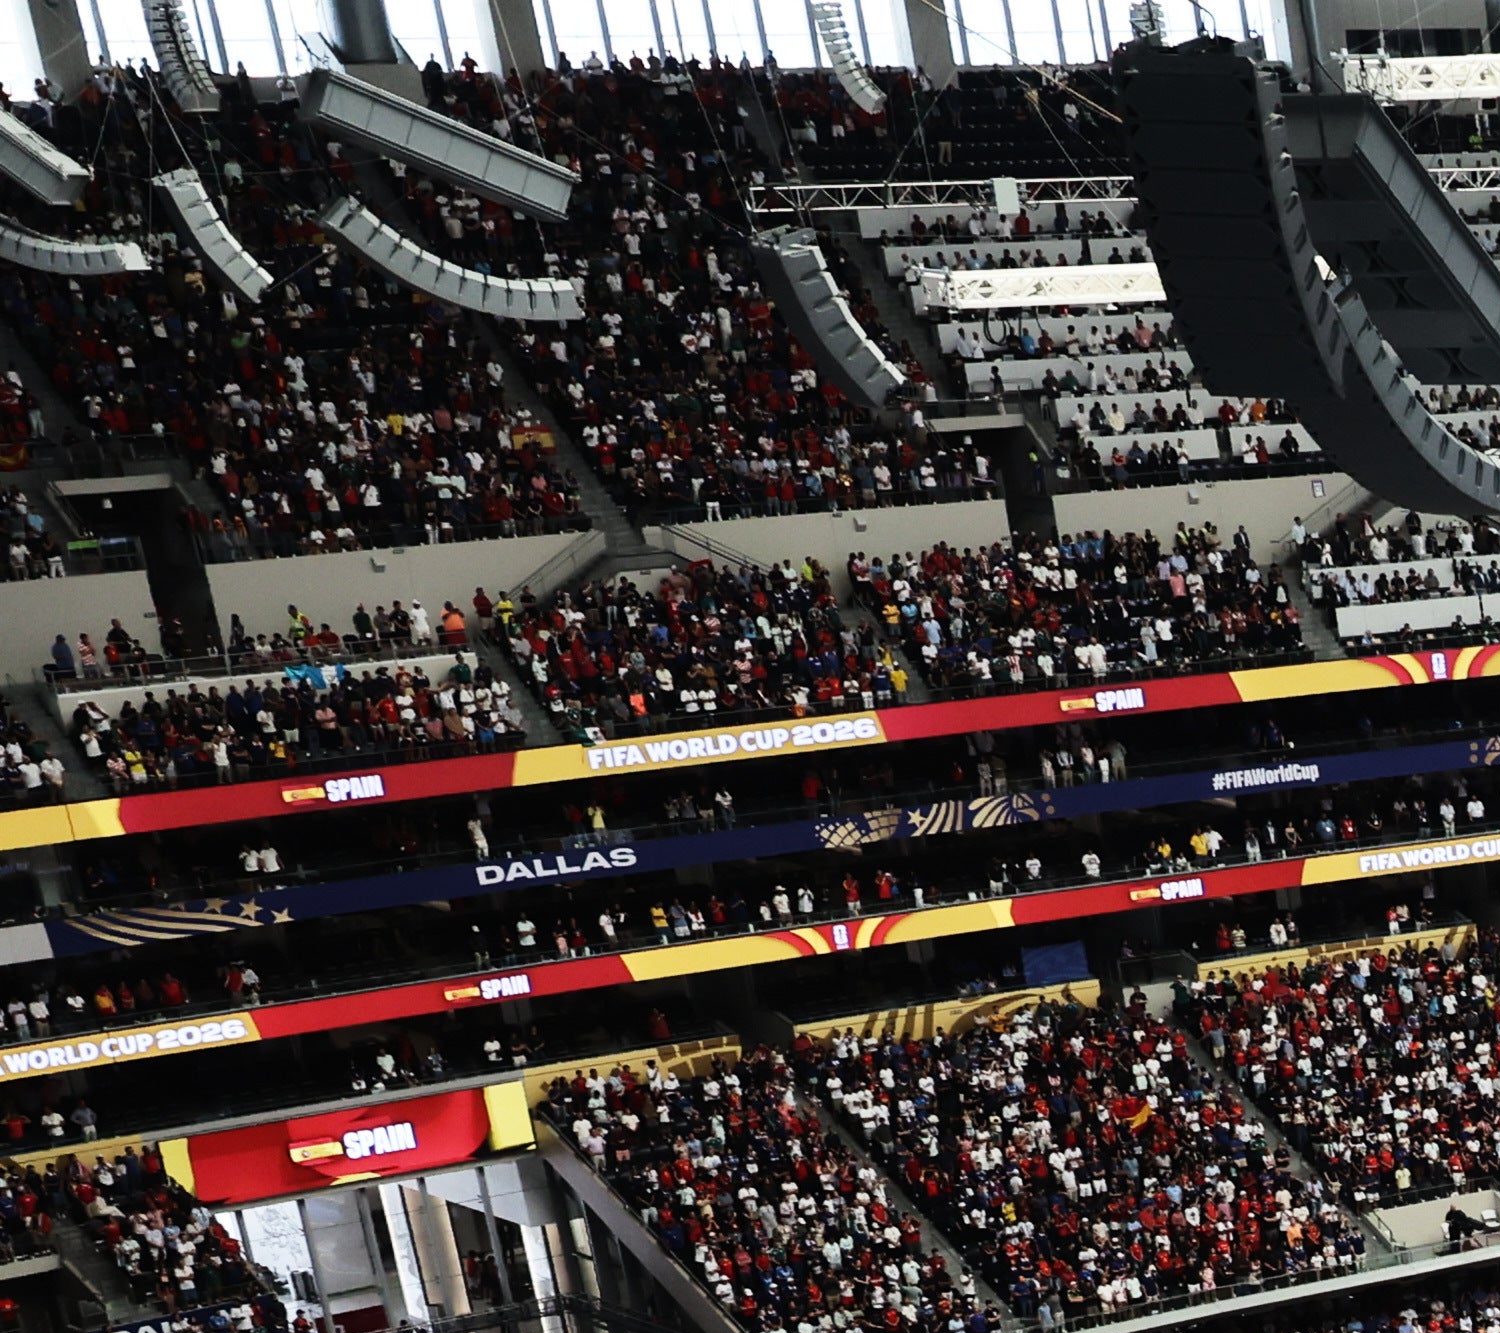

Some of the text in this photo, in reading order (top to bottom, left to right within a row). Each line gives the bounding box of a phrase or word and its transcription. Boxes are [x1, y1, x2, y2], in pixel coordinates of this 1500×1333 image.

[1095, 688, 1145, 712] SPAIN
[587, 718, 880, 770] FIFA WORLD CUP 2026
[325, 775, 384, 802] SPAIN
[1212, 765, 1319, 791] #FIFAWorldCup
[476, 847, 638, 885] DALLAS
[1360, 853, 1402, 874] FIFA
[1401, 843, 1470, 867] WORLD
[1160, 878, 1204, 900] SPAIN
[480, 974, 531, 999] SPAIN
[4, 1043, 101, 1075] WORLD
[101, 1032, 156, 1060] CUP
[156, 1018, 250, 1050] 2026
[343, 1122, 417, 1160] SPAIN
